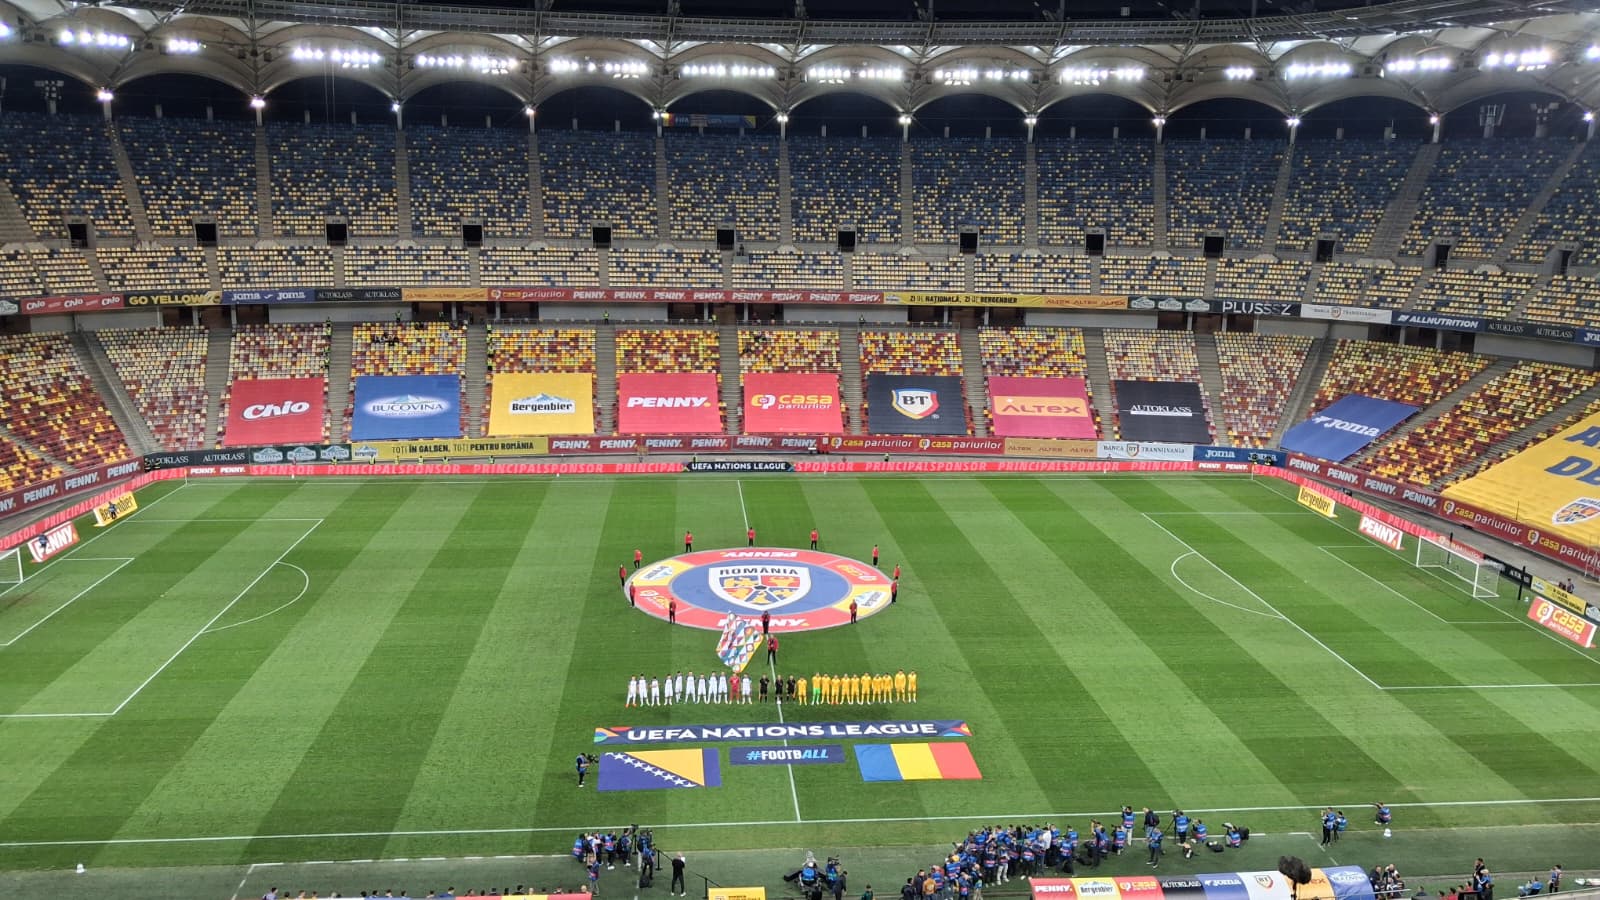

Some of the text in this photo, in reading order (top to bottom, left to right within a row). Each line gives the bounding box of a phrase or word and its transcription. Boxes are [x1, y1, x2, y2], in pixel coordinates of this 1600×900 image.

[129, 294, 208, 305] GO YELLOW
[1409, 314, 1479, 329] ALLNUTRITION
[1488, 323, 1524, 333] AUTOKLASS
[1535, 327, 1573, 338] AUTOKLASS
[627, 396, 711, 408] PENNY.
[778, 394, 833, 404] casa
[902, 395, 929, 405] BT
[242, 400, 311, 420] Chio
[372, 402, 444, 412] BUCOVINA
[512, 402, 573, 412] Bergenbier
[1130, 404, 1192, 413] AUTOKLASS
[470, 443, 499, 451] PENTRU
[864, 438, 913, 448] pariurilor
[931, 440, 1002, 449] casa pariurilor
[202, 452, 246, 463] AUTOKLASS
[254, 465, 315, 475] SPONSOR
[691, 462, 786, 470] UEFA NATIONS LEAGUE
[797, 462, 855, 472] SPONSOR
[1131, 461, 1195, 471] PRINCIPAL
[1254, 465, 1298, 483] SPONSOR
[1454, 507, 1523, 537] casa pariurilor
[1361, 517, 1397, 547] PENNY.
[1539, 536, 1561, 552] casa
[719, 565, 799, 576] ROMÂNIA
[1552, 608, 1586, 634] casa
[627, 723, 938, 741] UEFA NATIONS LEAGUE
[745, 748, 829, 761] #FOOTBALL
